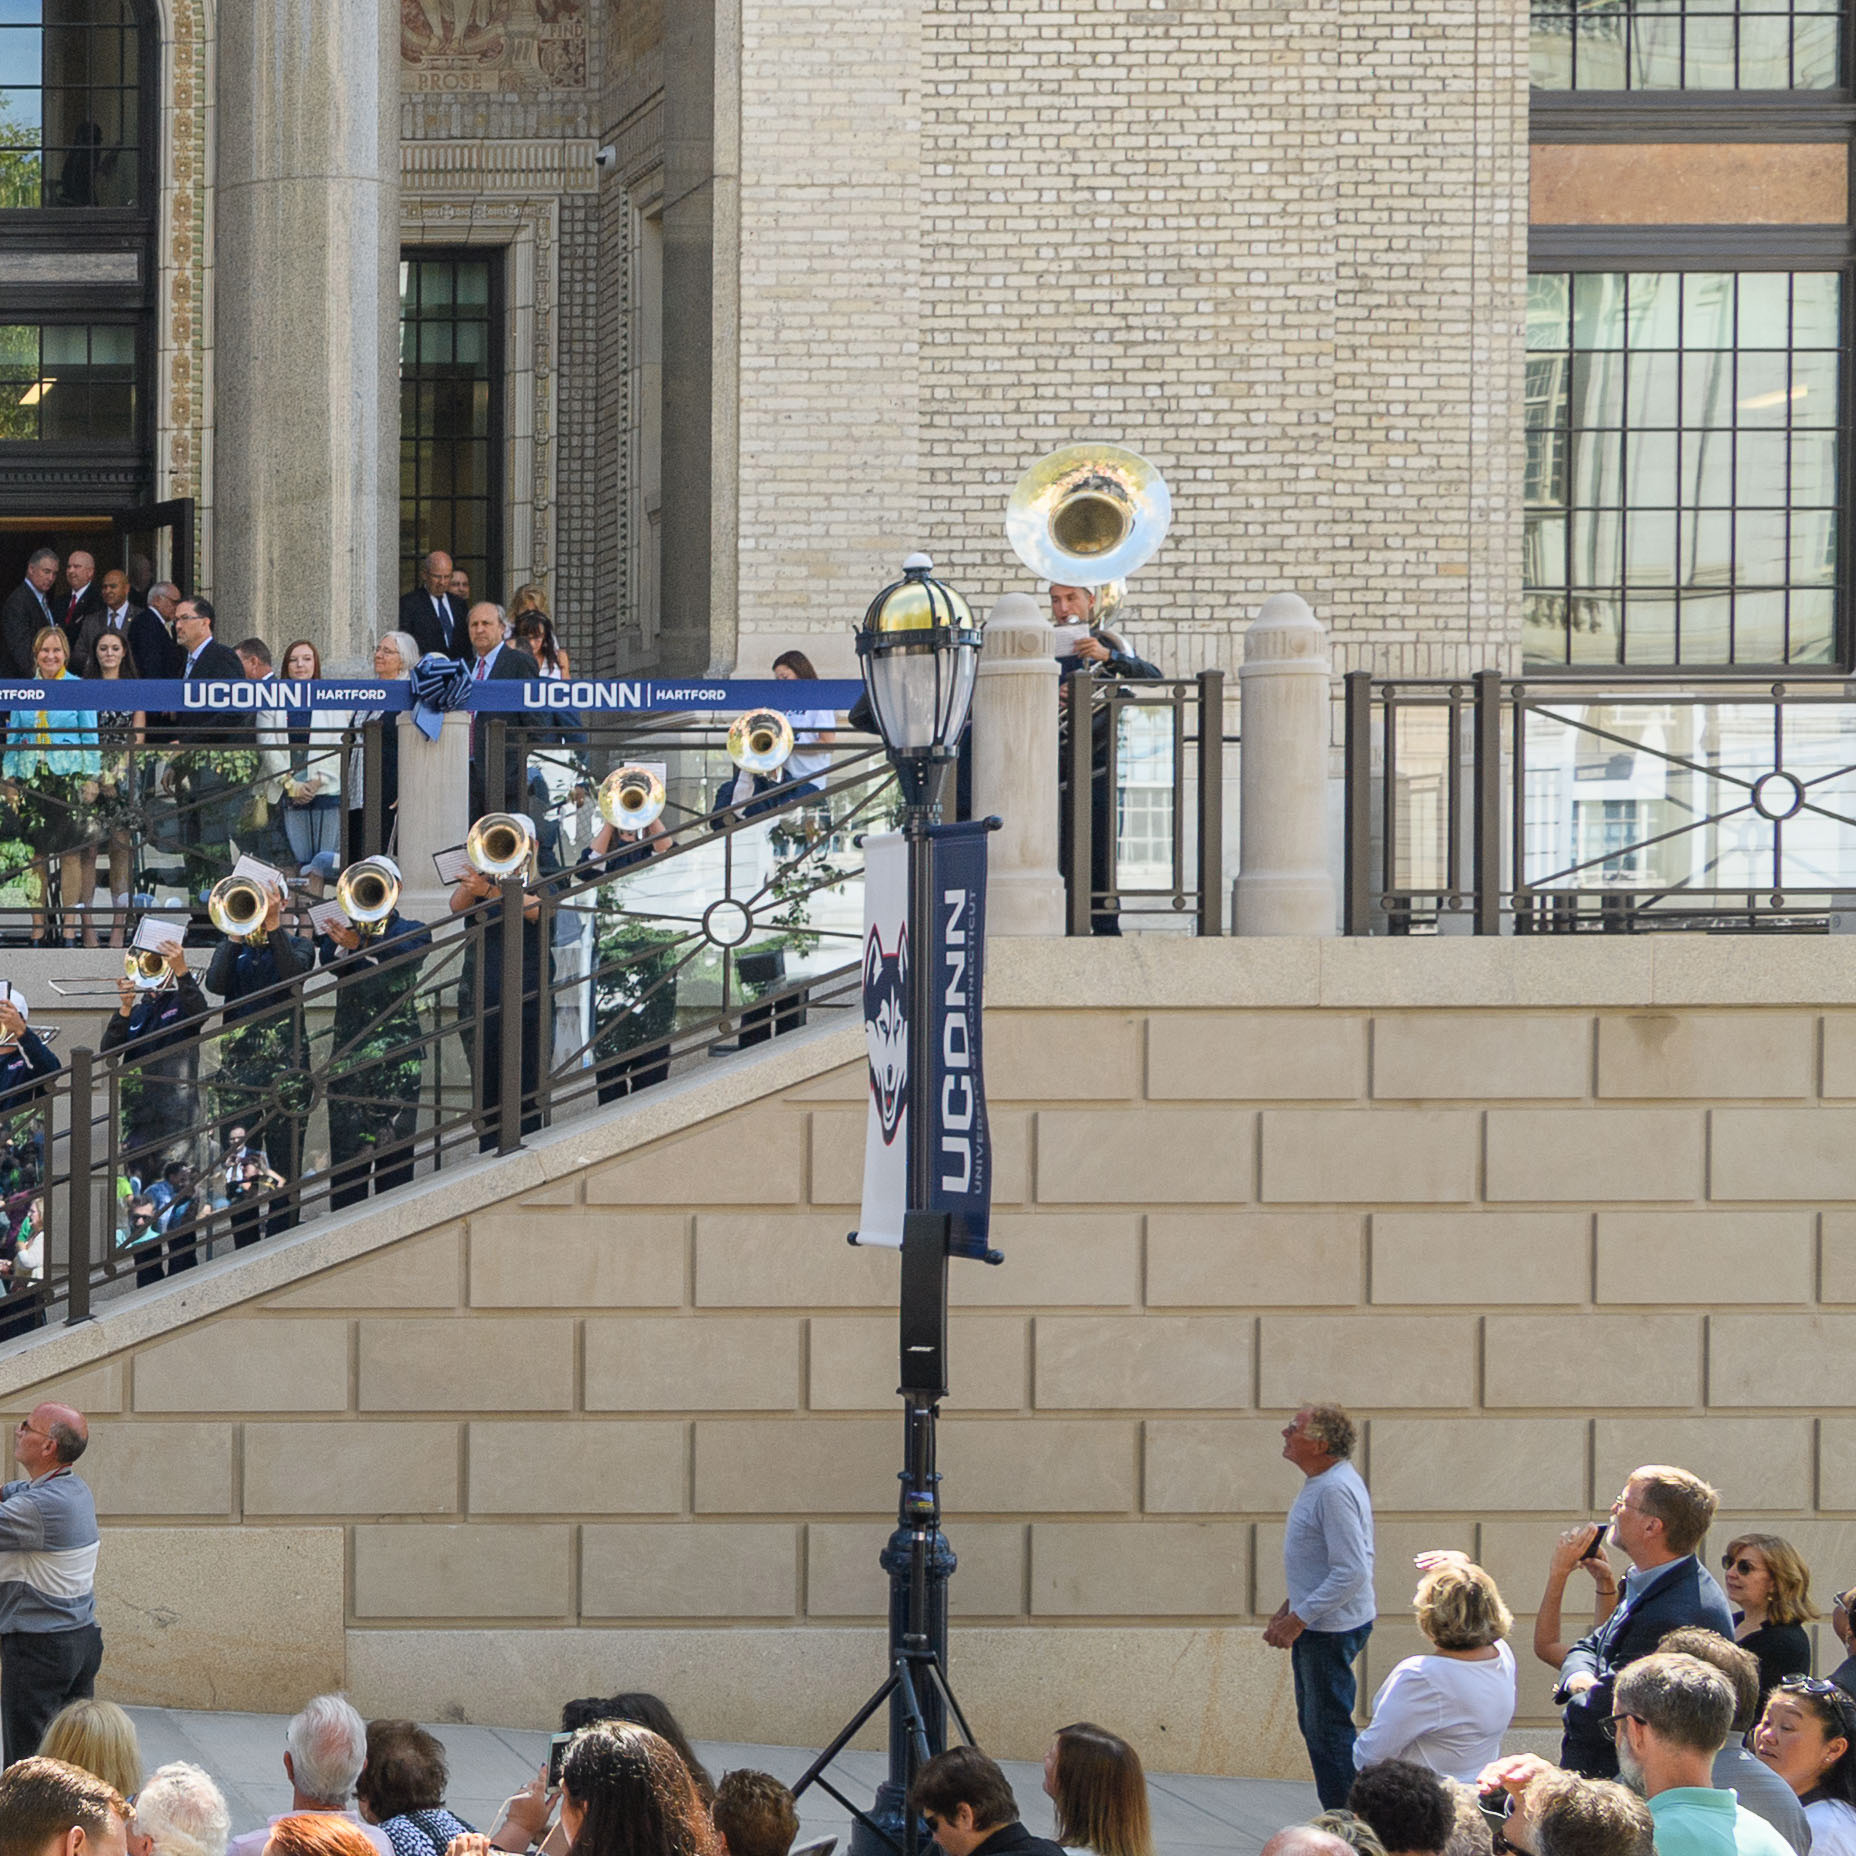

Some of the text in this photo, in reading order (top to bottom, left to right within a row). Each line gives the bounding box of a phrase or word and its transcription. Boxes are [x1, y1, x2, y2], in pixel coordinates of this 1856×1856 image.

[417, 72, 483, 91] PROSE
[183, 681, 387, 709] UCONN HARTFORD
[523, 681, 727, 708] UCONN HARTFORD
[967, 889, 978, 1036] CONNECTICUT
[941, 888, 973, 1194] UCONN
